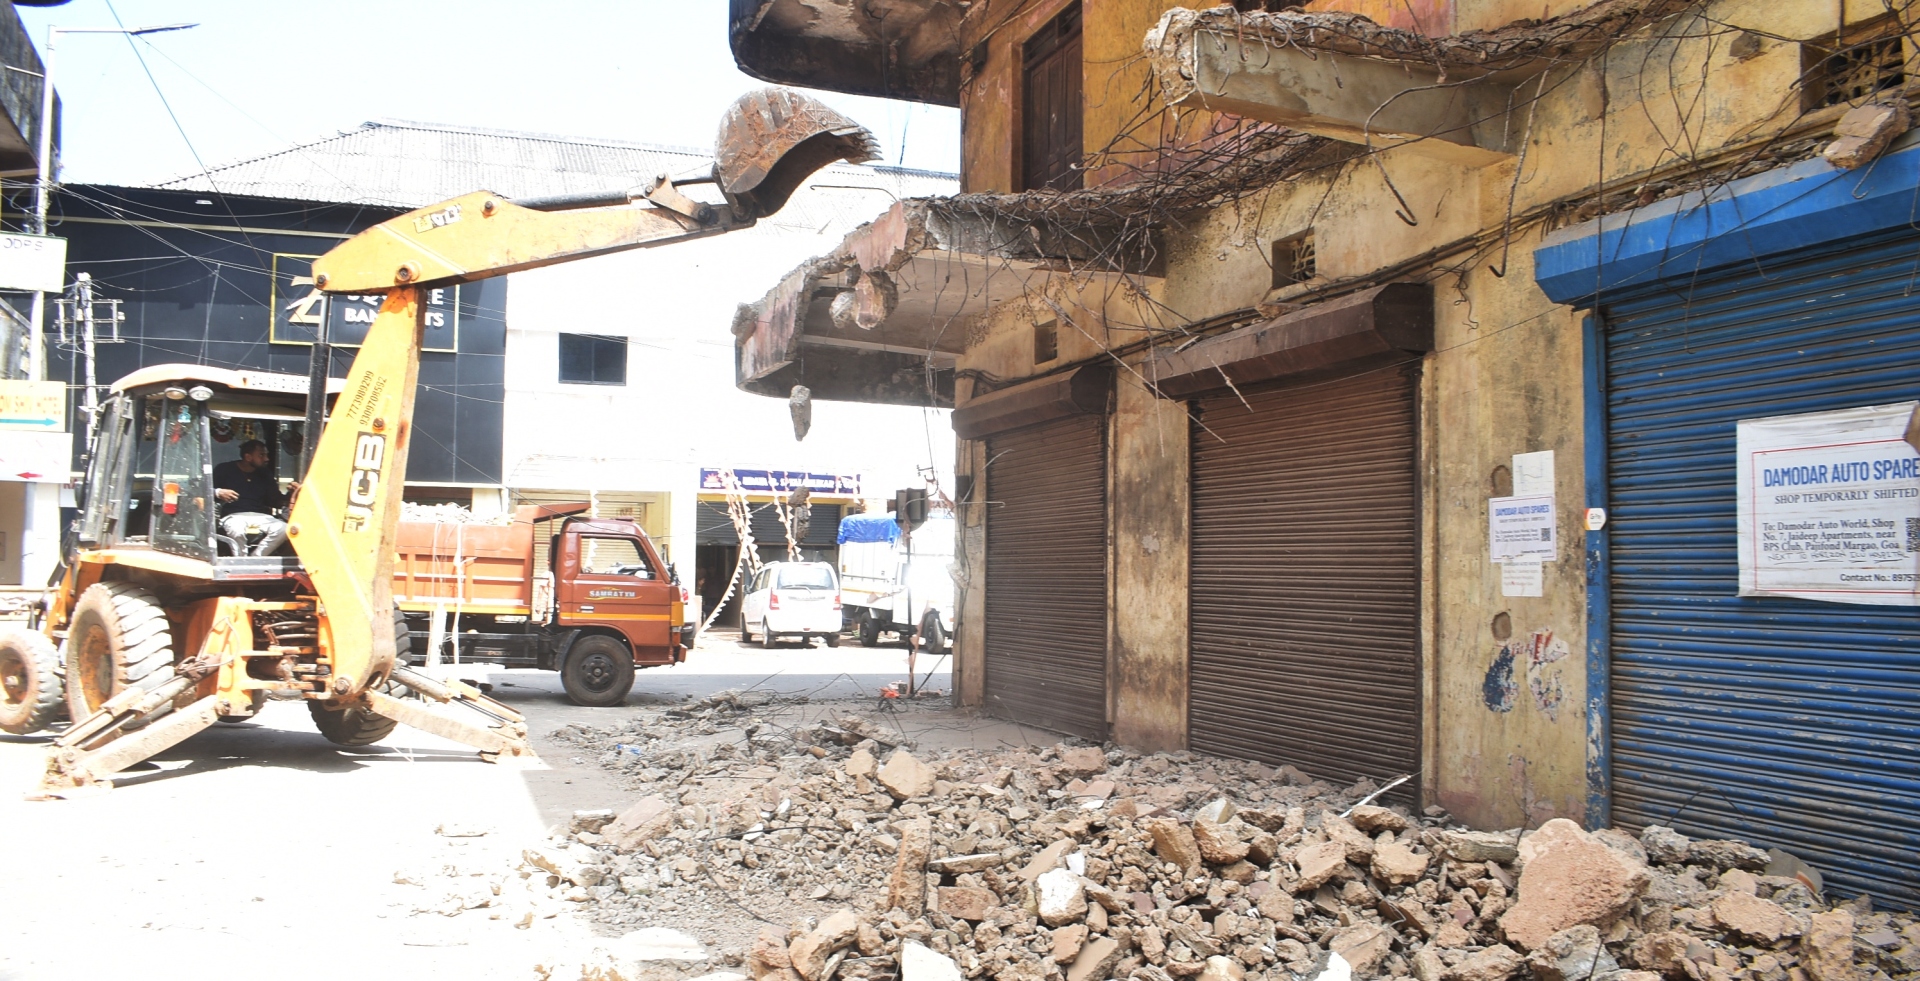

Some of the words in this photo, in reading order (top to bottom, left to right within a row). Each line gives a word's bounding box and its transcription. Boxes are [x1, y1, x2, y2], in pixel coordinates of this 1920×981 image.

[345, 307, 445, 328] BANTS
[1764, 464, 1828, 487] DAMODAR
[1831, 461, 1869, 483] AUTO
[1873, 457, 1920, 480] SPARE
[347, 433, 386, 532] JCB
[1775, 494, 1800, 504] SHOP
[1802, 490, 1869, 503] TEMPORARLY
[1874, 487, 1919, 499] SHIFTED
[1762, 522, 1776, 531] To:
[1777, 521, 1816, 531] Damodar
[1817, 520, 1839, 529] Auto
[1840, 518, 1870, 529] World,
[1872, 518, 1895, 530] Shop
[1763, 532, 1776, 541] No.
[1788, 532, 1819, 542] Jaideep
[1820, 531, 1874, 542] Apartments,
[1875, 531, 1896, 539] near
[1763, 543, 1779, 551] BPS
[1768, 552, 1793, 561] NEXT
[1840, 573, 1873, 582] Contact
